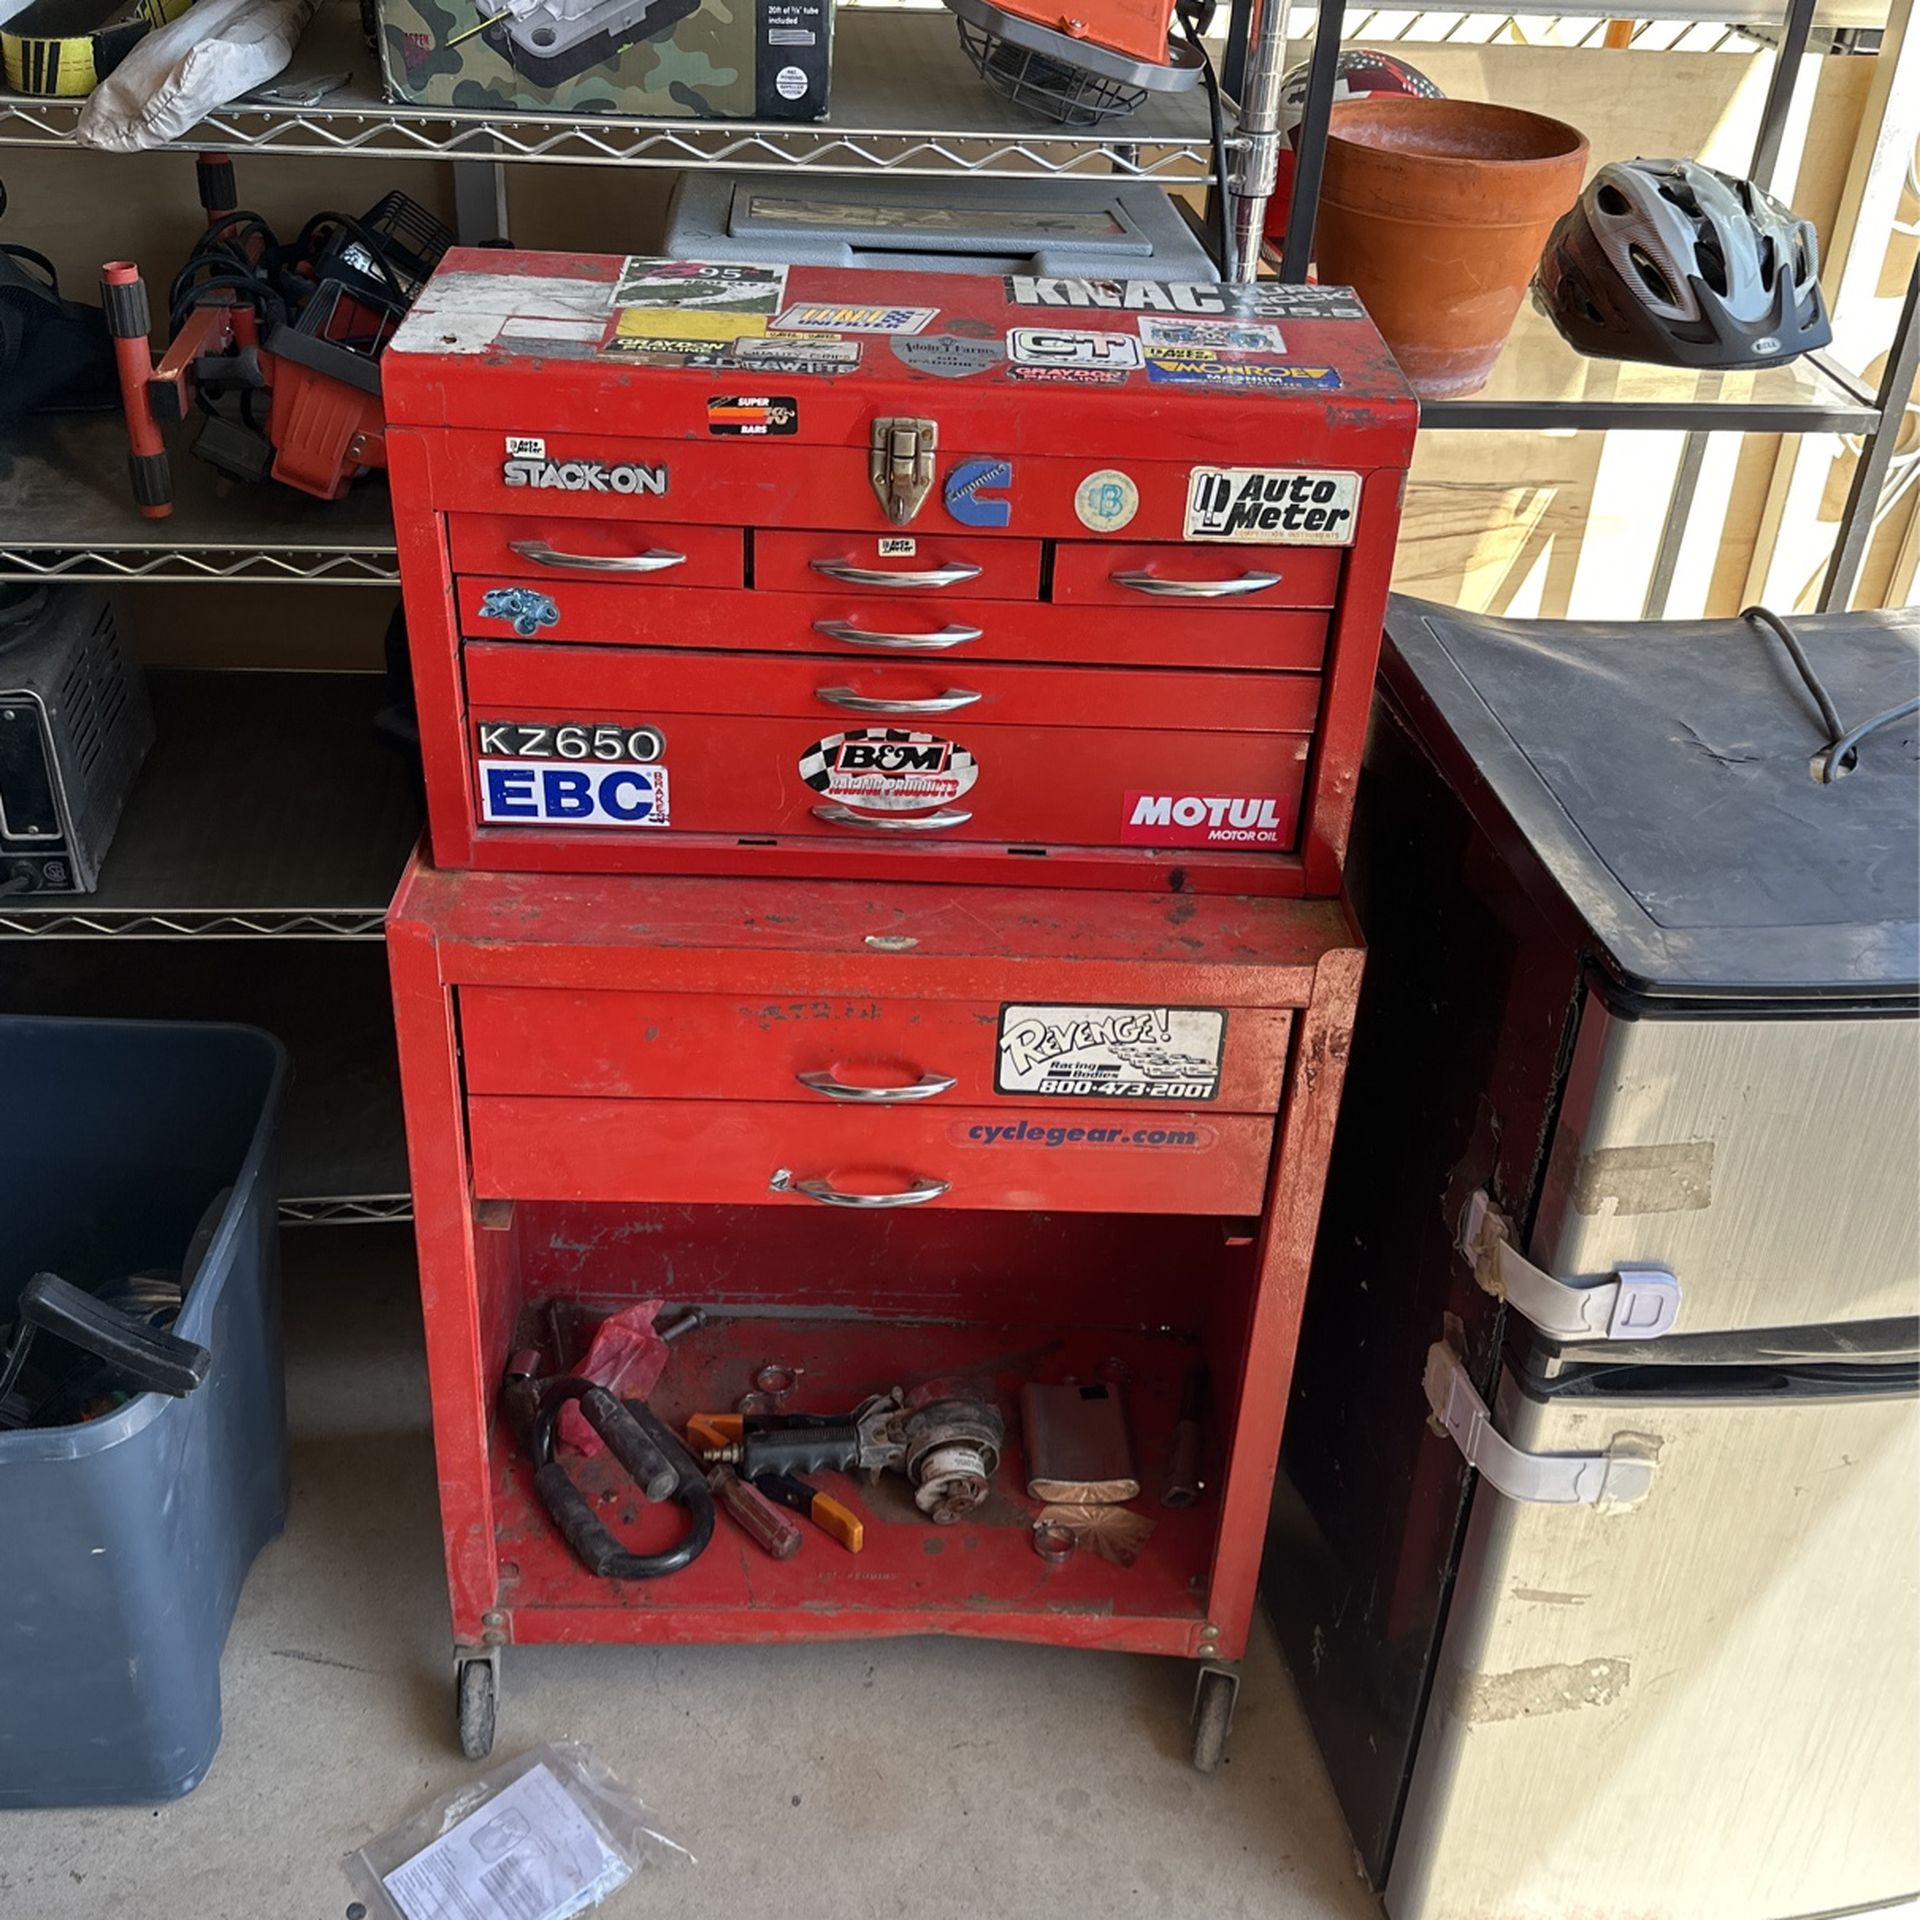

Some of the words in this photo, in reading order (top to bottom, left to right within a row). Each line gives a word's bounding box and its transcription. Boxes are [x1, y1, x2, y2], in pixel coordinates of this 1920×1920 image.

[698, 267, 742, 280] 95
[1174, 362, 1310, 378] MONROE
[737, 397, 770, 407] SUPER
[740, 425, 768, 434] BARS
[502, 459, 667, 496] STACK-ON
[1235, 474, 1337, 503] Auto
[1228, 501, 1351, 532] Meter
[479, 726, 661, 762] KZ650
[839, 744, 949, 771] B&M
[487, 768, 654, 821] EBC
[1129, 796, 1281, 829] MOTUL
[1207, 830, 1257, 841] MOTOR
[1256, 831, 1278, 842] OIL
[1050, 1061, 1097, 1071] Racing
[1072, 1070, 1119, 1079] Bodies
[968, 1120, 1197, 1147] cyclegear.com
